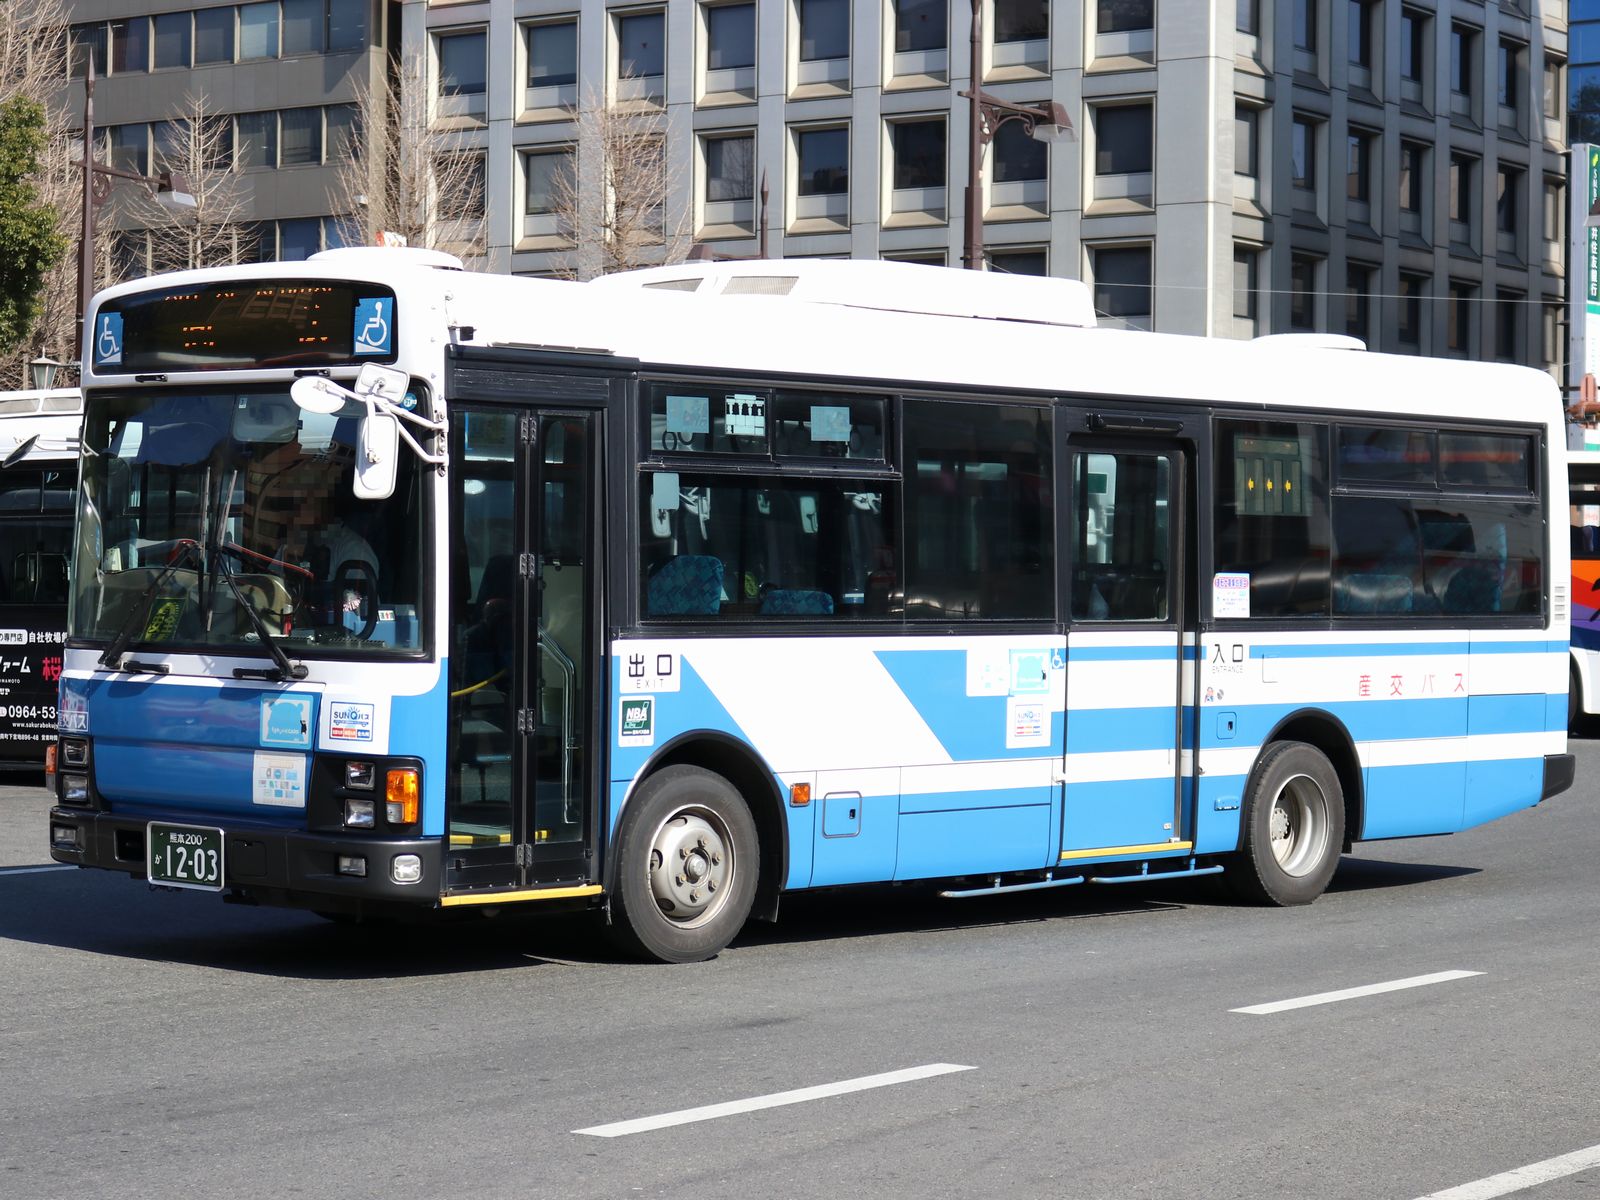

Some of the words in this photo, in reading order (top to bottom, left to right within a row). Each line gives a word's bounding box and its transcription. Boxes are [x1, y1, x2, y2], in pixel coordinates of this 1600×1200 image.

[628, 652, 673, 678] 出口
[1212, 643, 1244, 664] 入口
[636, 678, 664, 689] EXIT
[1358, 673, 1465, 697] 産交バス
[166, 844, 218, 882] 12-03
